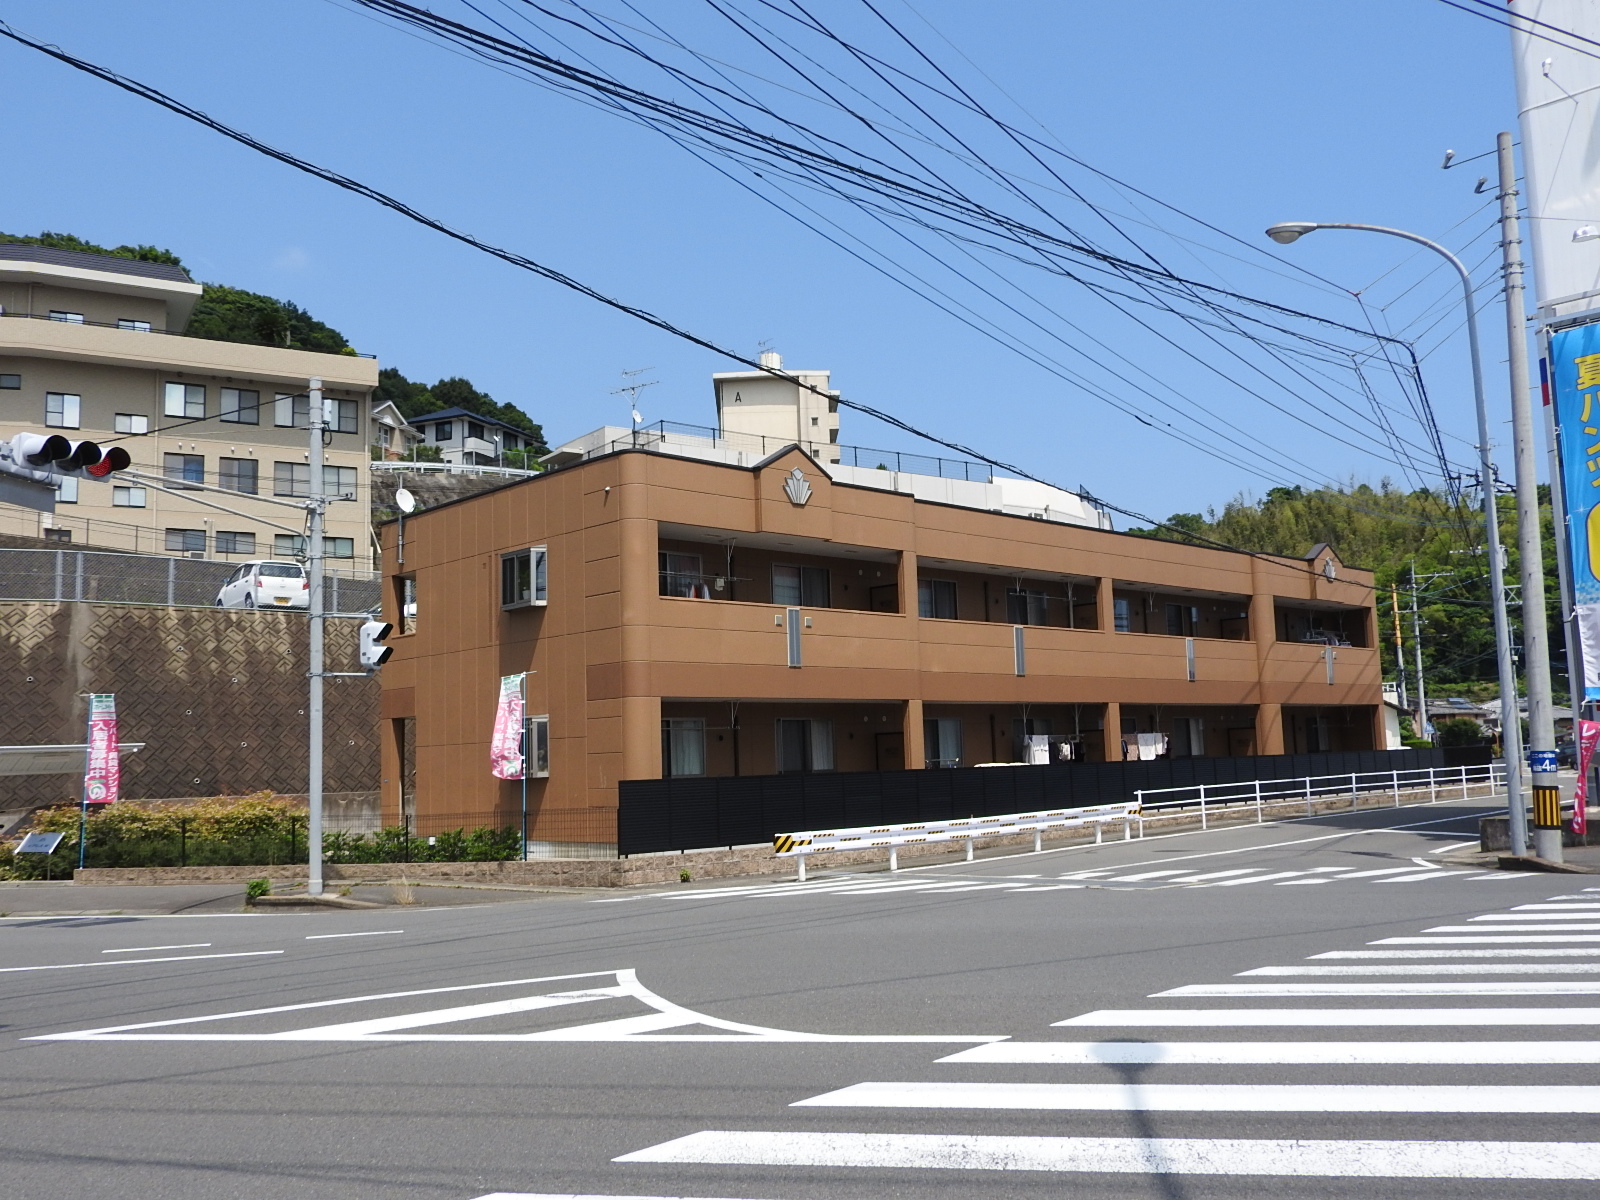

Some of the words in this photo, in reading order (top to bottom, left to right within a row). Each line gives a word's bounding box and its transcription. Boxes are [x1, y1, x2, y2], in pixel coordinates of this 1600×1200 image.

[734, 391, 742, 403] A
[89, 720, 109, 778] 入居者募集中
